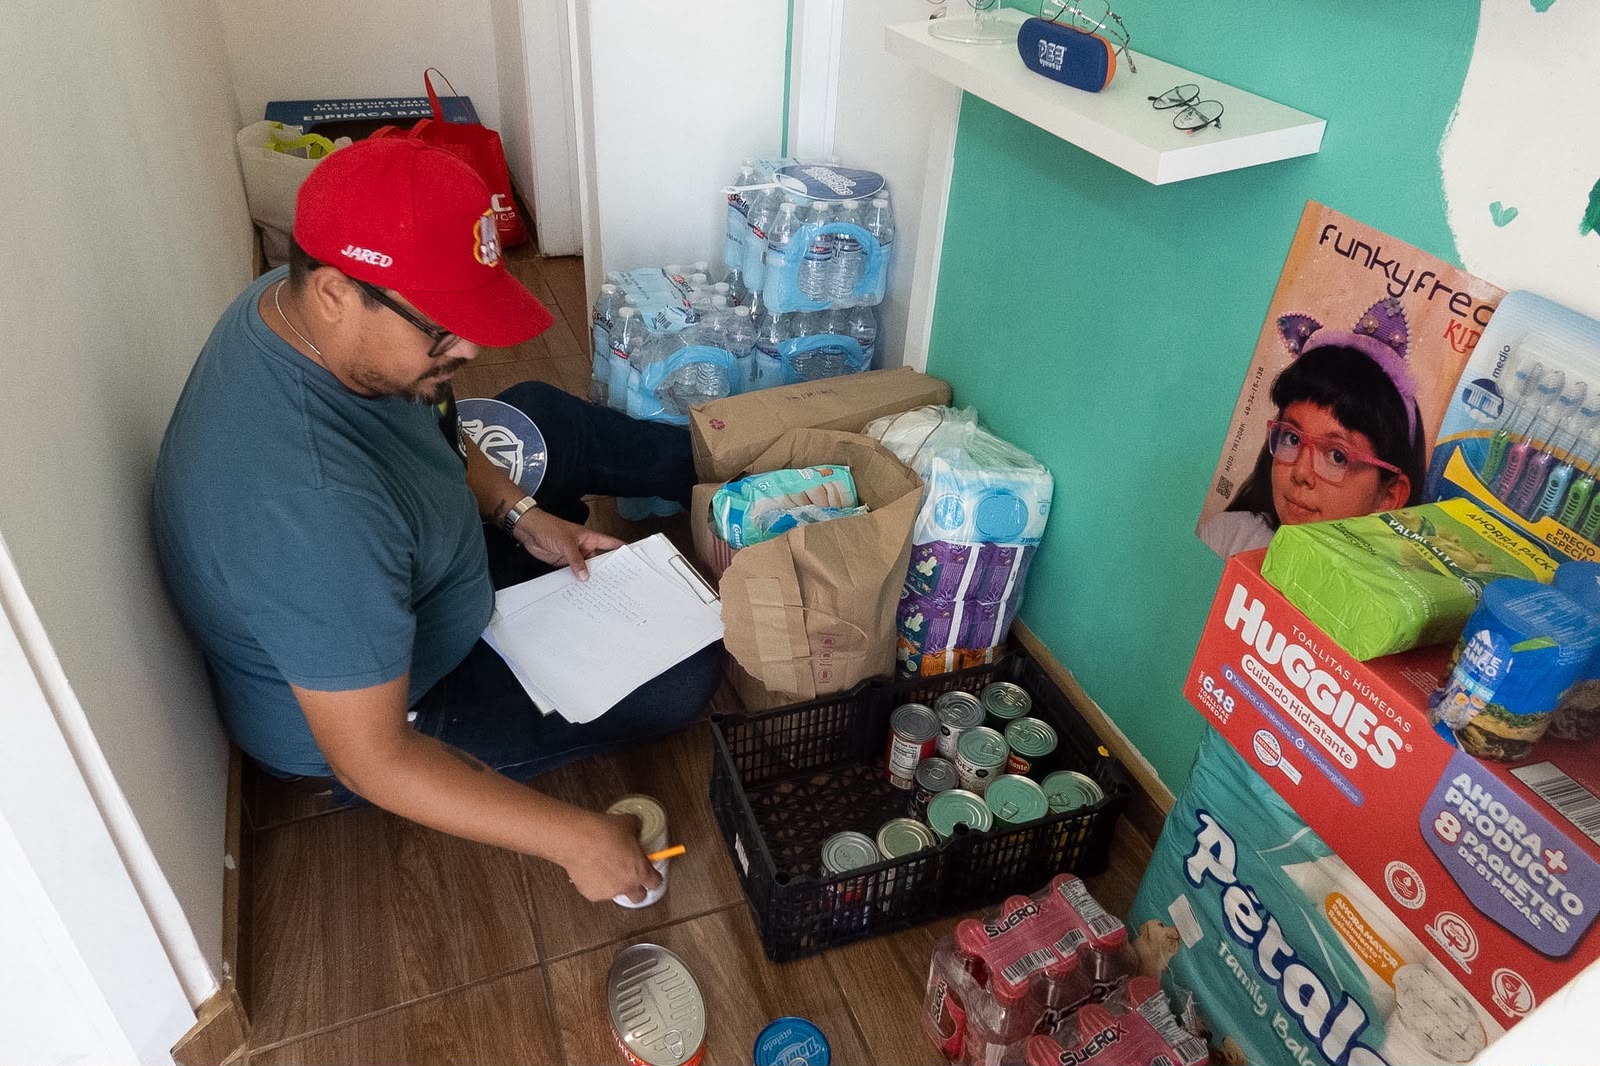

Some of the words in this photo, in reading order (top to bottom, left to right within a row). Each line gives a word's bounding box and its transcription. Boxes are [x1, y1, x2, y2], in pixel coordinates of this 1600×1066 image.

[303, 111, 392, 121] ESPINACA
[396, 109, 435, 117] BAB
[340, 244, 394, 268] JARED
[1492, 344, 1511, 379] medio
[1465, 513, 1518, 548] AHORRA
[1545, 532, 1593, 561] ESPECIA
[1556, 528, 1596, 557] PRECIO
[1202, 676, 1235, 714] 648
[1224, 583, 1403, 769] HUGGIES
[1291, 625, 1351, 681] TOALLITAS
[1352, 677, 1412, 733] HÚMEDAS
[1199, 688, 1229, 719] TOALLITAS
[1245, 659, 1289, 706] Cuidado
[1289, 700, 1353, 766] Hidratante
[1234, 679, 1257, 704] Alcohol
[1259, 702, 1292, 738] Parabenos
[1304, 746, 1360, 802] Hipoalergénicas
[1452, 773, 1542, 857] AHORA
[1445, 786, 1584, 916] PRODUCTO
[1457, 846, 1478, 868] DE
[1476, 864, 1492, 882] 81
[1434, 811, 1462, 843] 8
[1463, 831, 1571, 934] PAQUETES
[984, 901, 1048, 938] SUEROX
[1335, 897, 1365, 934] AHORA
[1362, 930, 1399, 969] MAYOR
[1218, 940, 1268, 1017] Family
[1058, 1020, 1129, 1066] SUEROX
